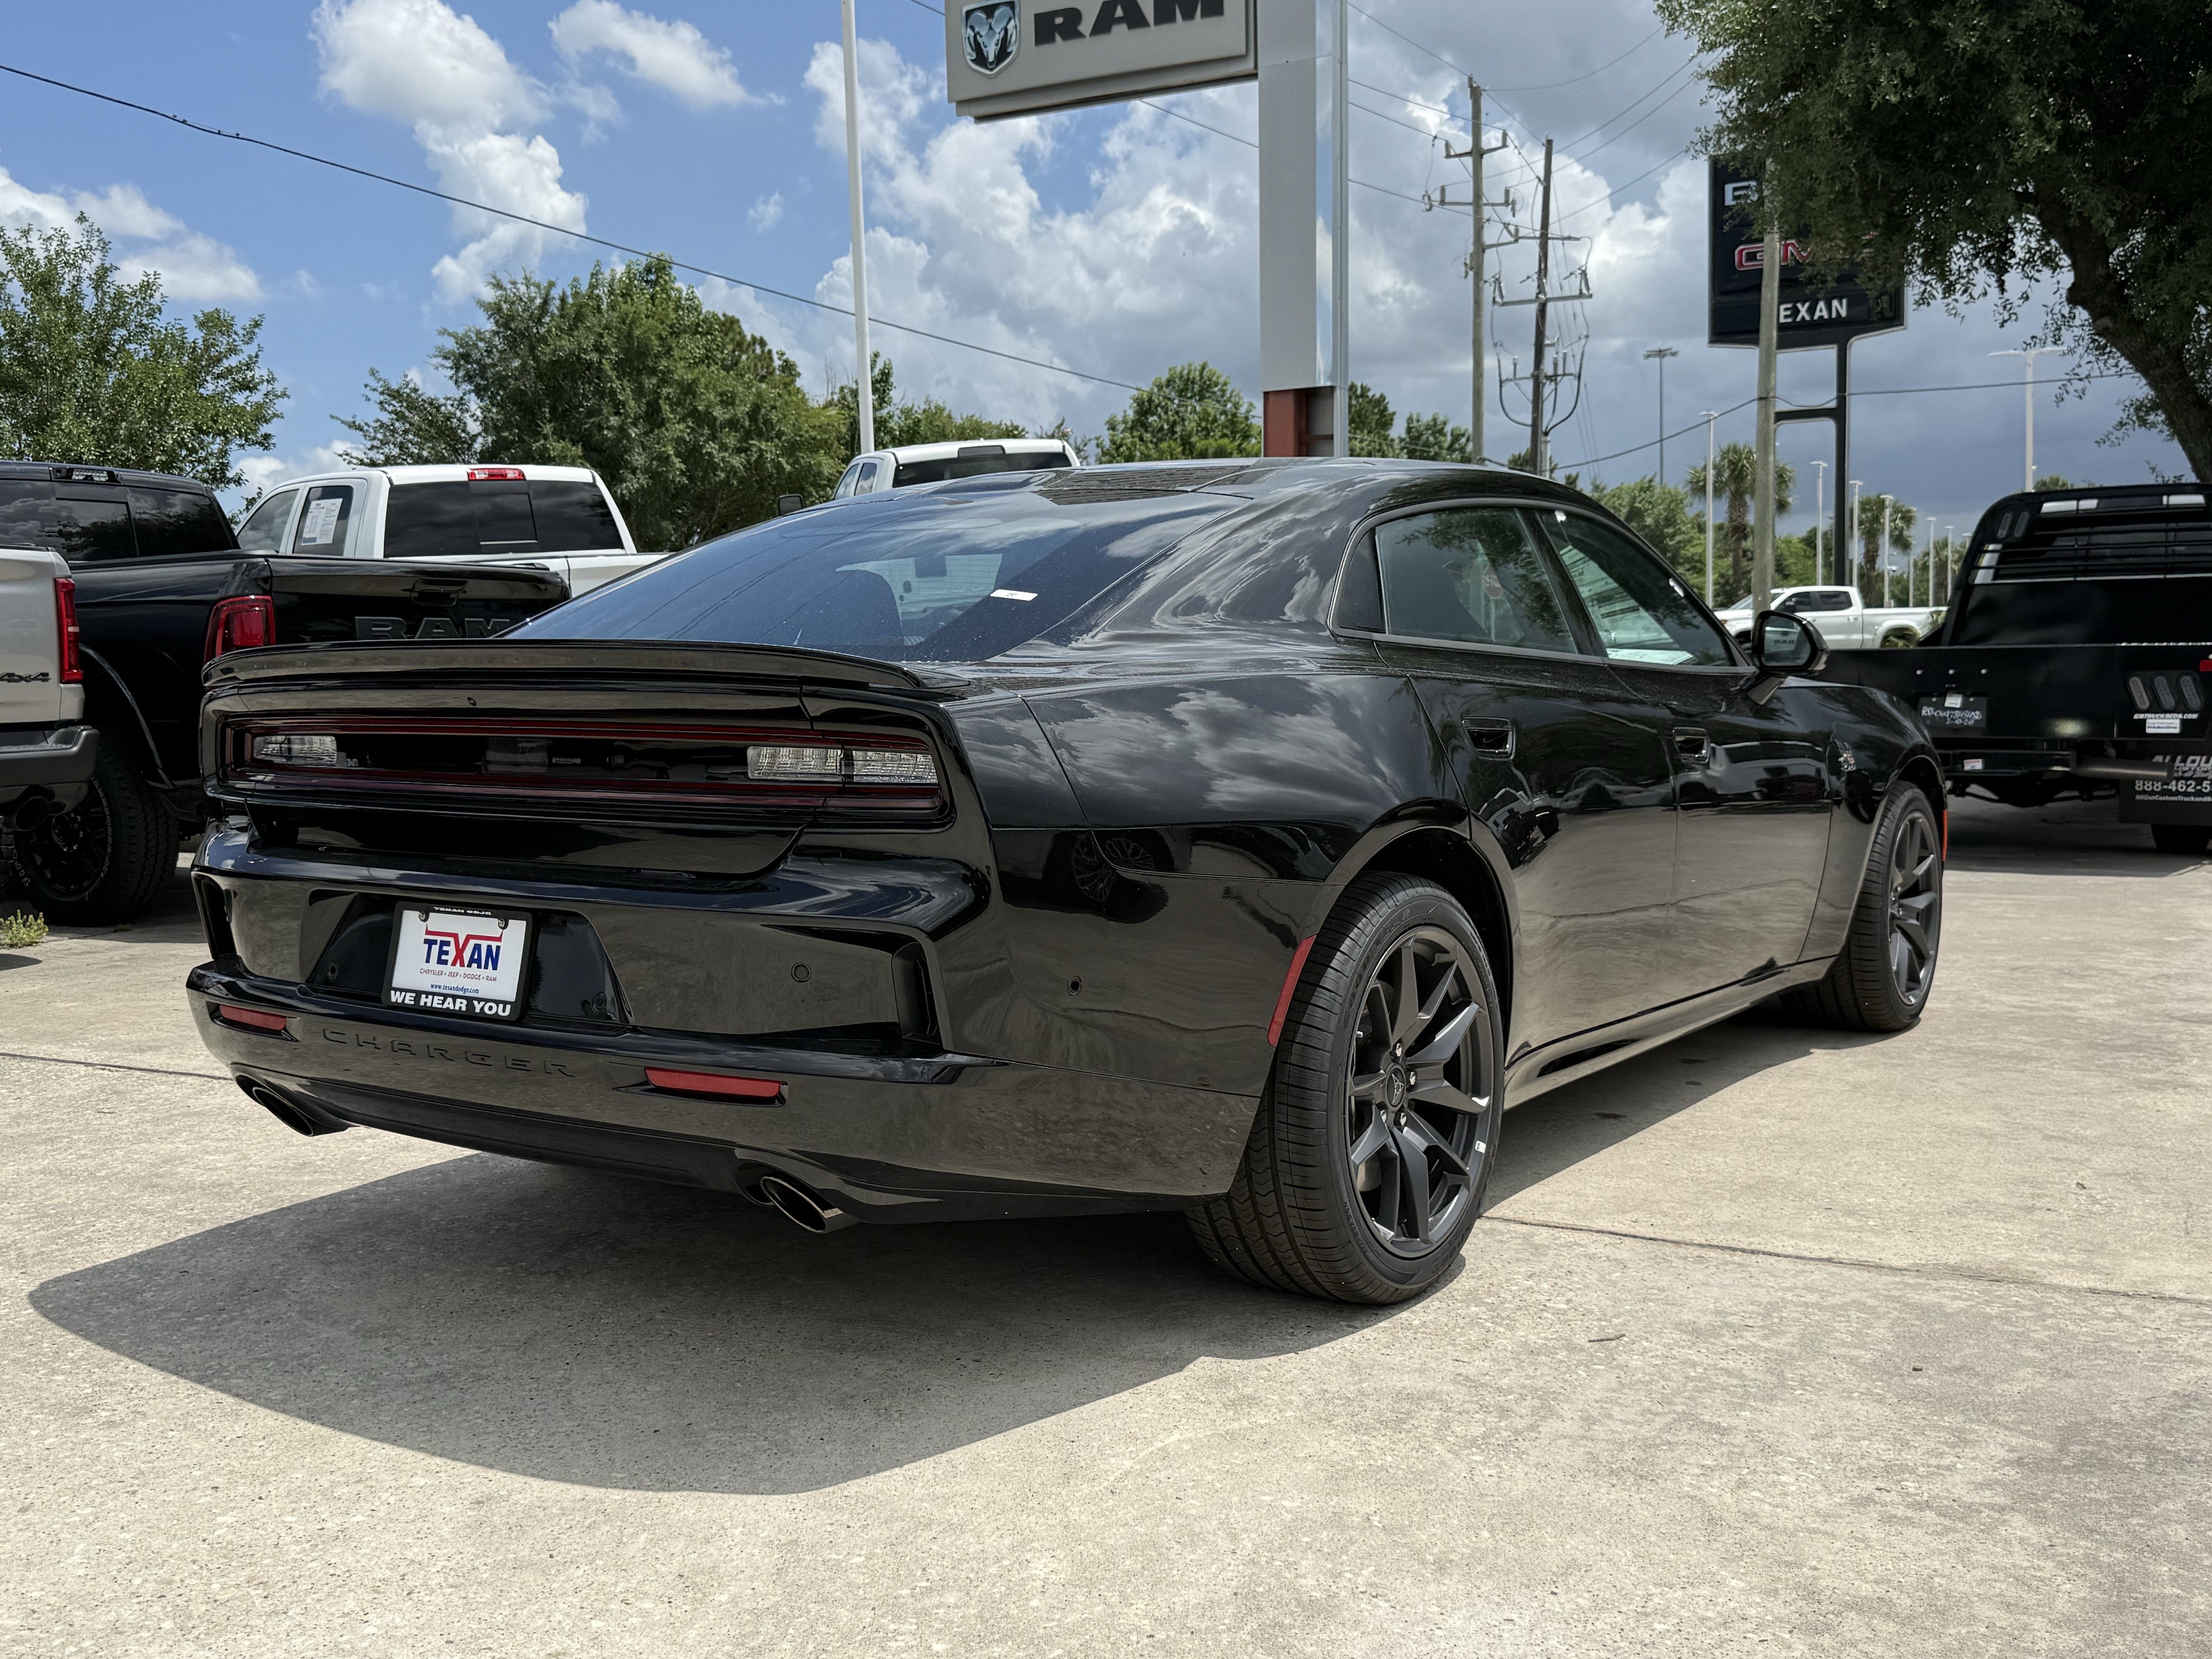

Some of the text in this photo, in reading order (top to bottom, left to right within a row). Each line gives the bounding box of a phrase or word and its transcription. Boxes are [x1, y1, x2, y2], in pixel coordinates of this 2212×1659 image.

[1034, 0, 1224, 46] RAM
[1778, 298, 1848, 323] EXAN
[355, 617, 510, 639] RAM
[2135, 780, 2212, 793] 888-462-5
[423, 930, 502, 970] TEXAN
[430, 983, 479, 994] www.texandodge.com
[390, 990, 511, 1016] WE HEAR YOU
[323, 1028, 575, 1077] CHARGER
